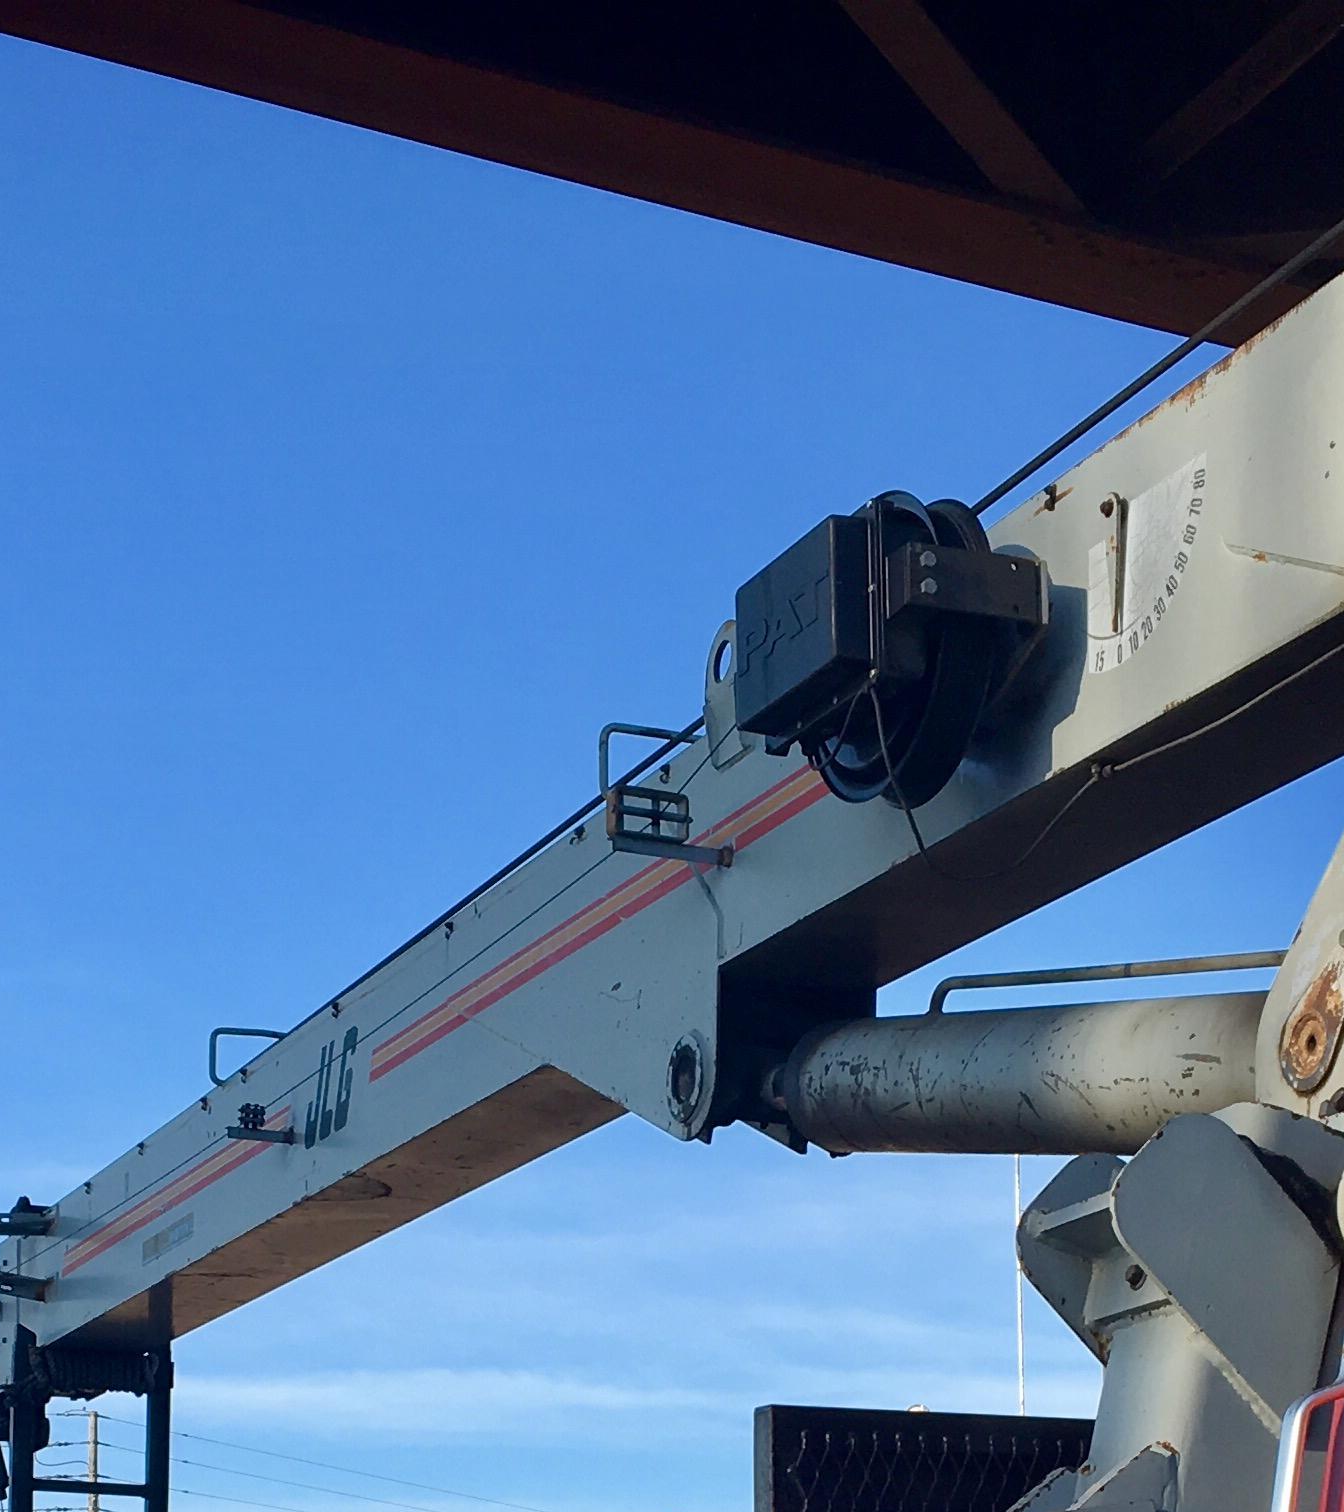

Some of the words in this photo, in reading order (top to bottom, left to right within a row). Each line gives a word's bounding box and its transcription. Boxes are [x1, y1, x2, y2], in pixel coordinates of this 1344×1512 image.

[1193, 468, 1206, 490] 80
[1189, 498, 1203, 517] 70
[1183, 524, 1197, 547] 60
[1174, 552, 1189, 574] 50
[1165, 575, 1178, 598] 40
[1153, 597, 1167, 621] 30
[1141, 615, 1153, 641] 20
[1129, 630, 1139, 654] 10
[1095, 651, 1105, 672] 15
[1117, 644, 1123, 664] 0
[305, 1025, 359, 1150] JLG
